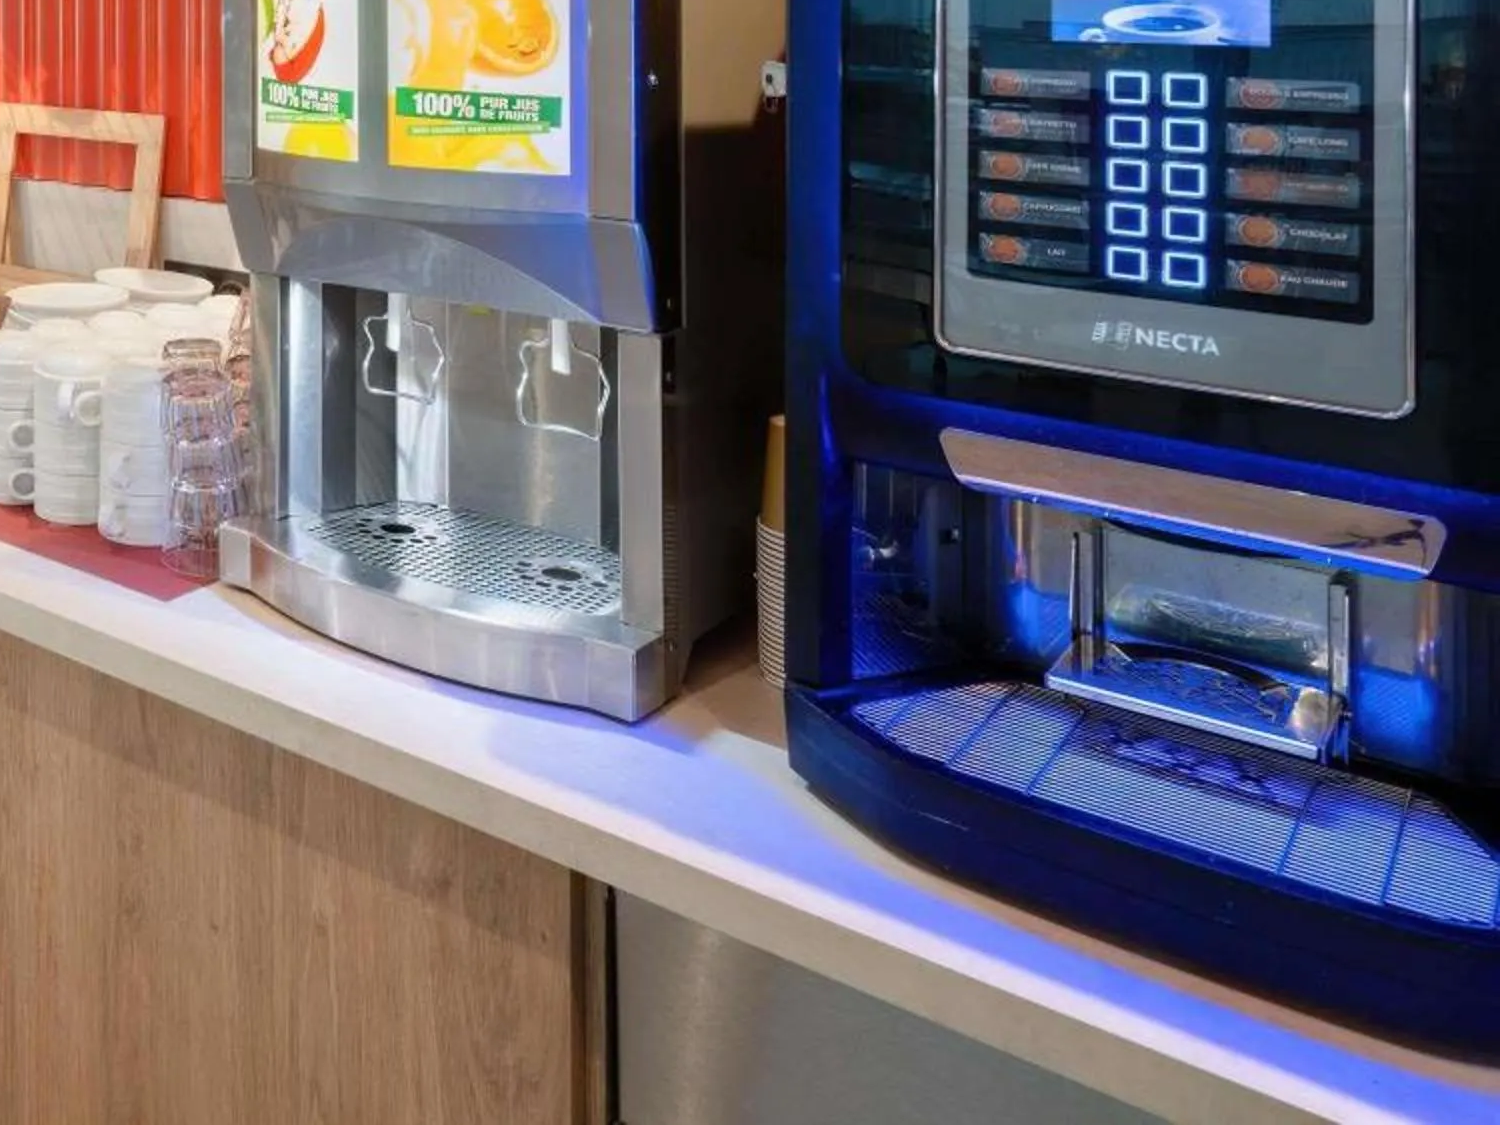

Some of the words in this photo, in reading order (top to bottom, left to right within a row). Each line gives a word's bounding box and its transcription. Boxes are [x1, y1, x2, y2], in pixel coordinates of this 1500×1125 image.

[267, 81, 300, 108] 100%
[412, 90, 476, 120] 100%
[479, 95, 509, 109] PUR
[512, 98, 541, 112] JUS
[479, 108, 495, 120] DE
[499, 110, 540, 122] FRUITS
[1134, 326, 1221, 357] NECTA
